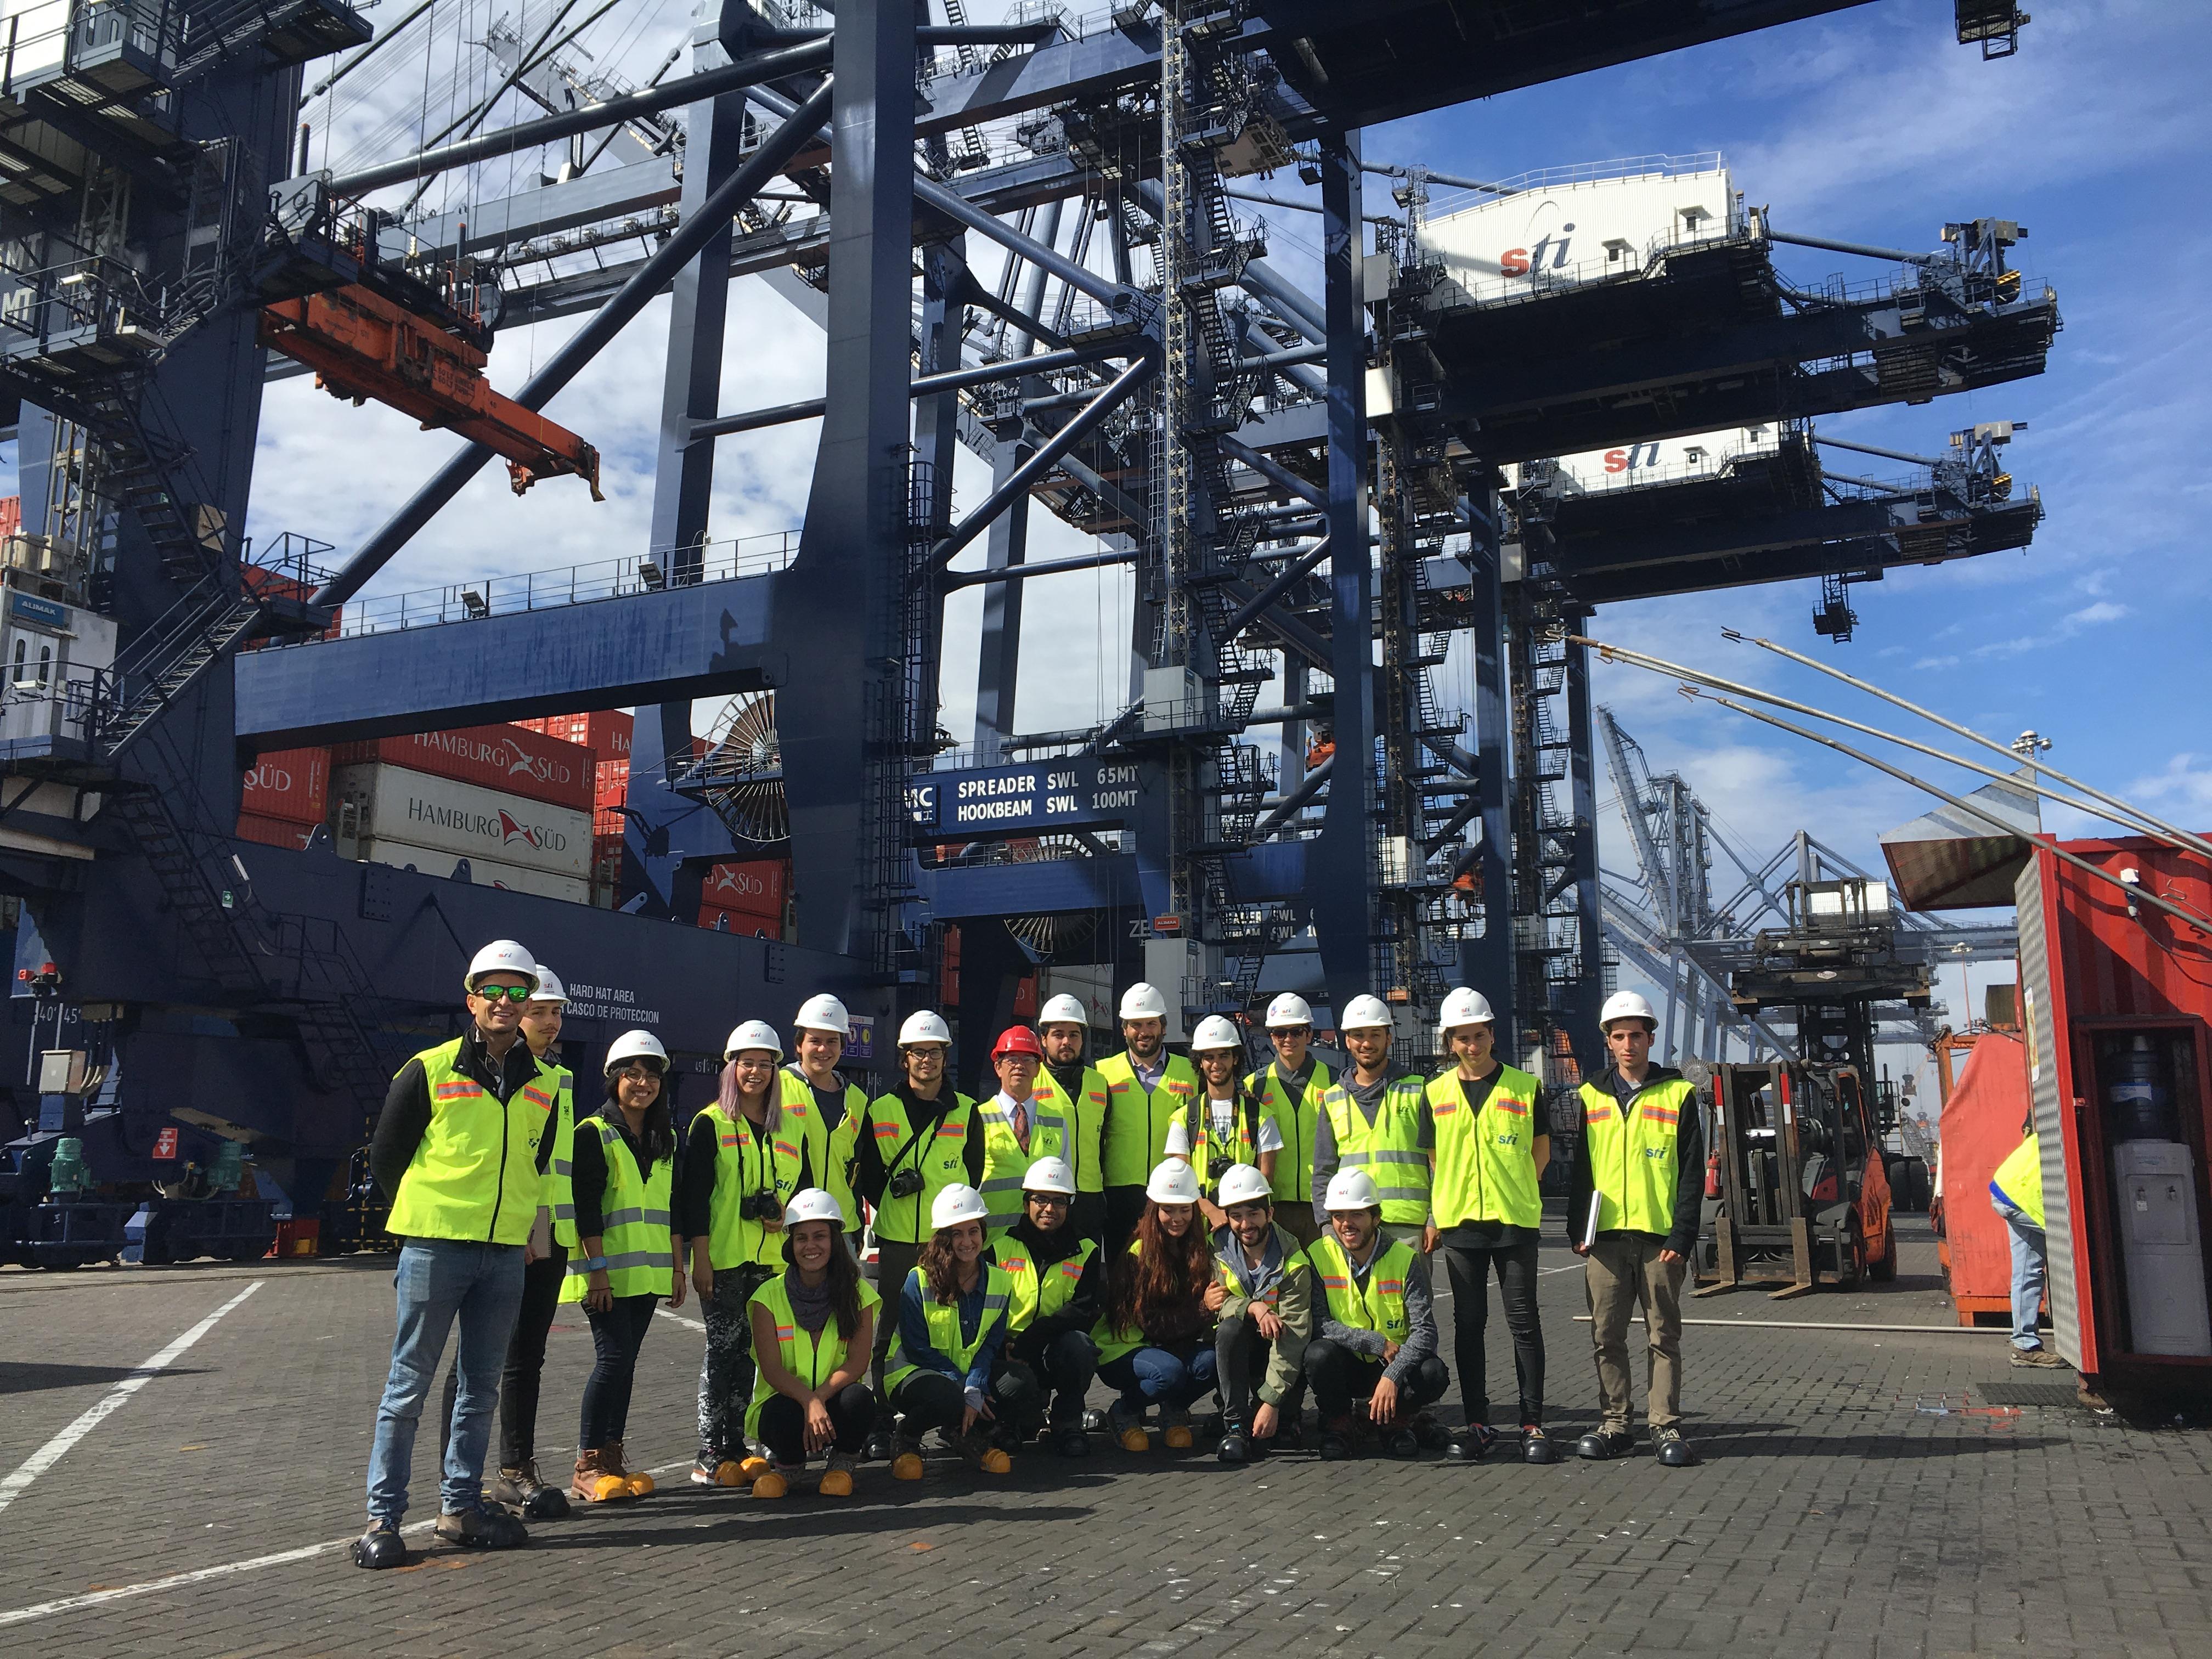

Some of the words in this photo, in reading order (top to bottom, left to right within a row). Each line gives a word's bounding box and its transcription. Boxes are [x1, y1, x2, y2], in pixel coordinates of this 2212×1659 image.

[1500, 223, 1576, 278] sti
[22, 601, 55, 615] ALIMAK
[414, 733, 505, 766] HAMBURG
[538, 757, 571, 783] SÜD
[958, 775, 1036, 798] SPREADER
[1047, 771, 1079, 789] SWL
[1097, 766, 1138, 785] 65MT
[958, 799, 1032, 821] HOOKBEAM
[1047, 795, 1078, 814] SWL
[1092, 790, 1138, 809] 100MT
[408, 798, 500, 837] HAMBURG
[534, 826, 566, 851] SÜD
[739, 873, 763, 894] SÜD
[570, 983, 593, 998] HARD
[596, 986, 612, 1001] HAT
[613, 989, 635, 1003] AREA
[567, 1002, 595, 1017] CASCO
[597, 1005, 608, 1018] DE
[611, 1006, 659, 1024] PROTECCION
[1498, 1133, 1519, 1146] sti
[943, 1156, 959, 1170] sti
[1646, 1147, 1667, 1159] sti
[776, 1179, 793, 1192] sti
